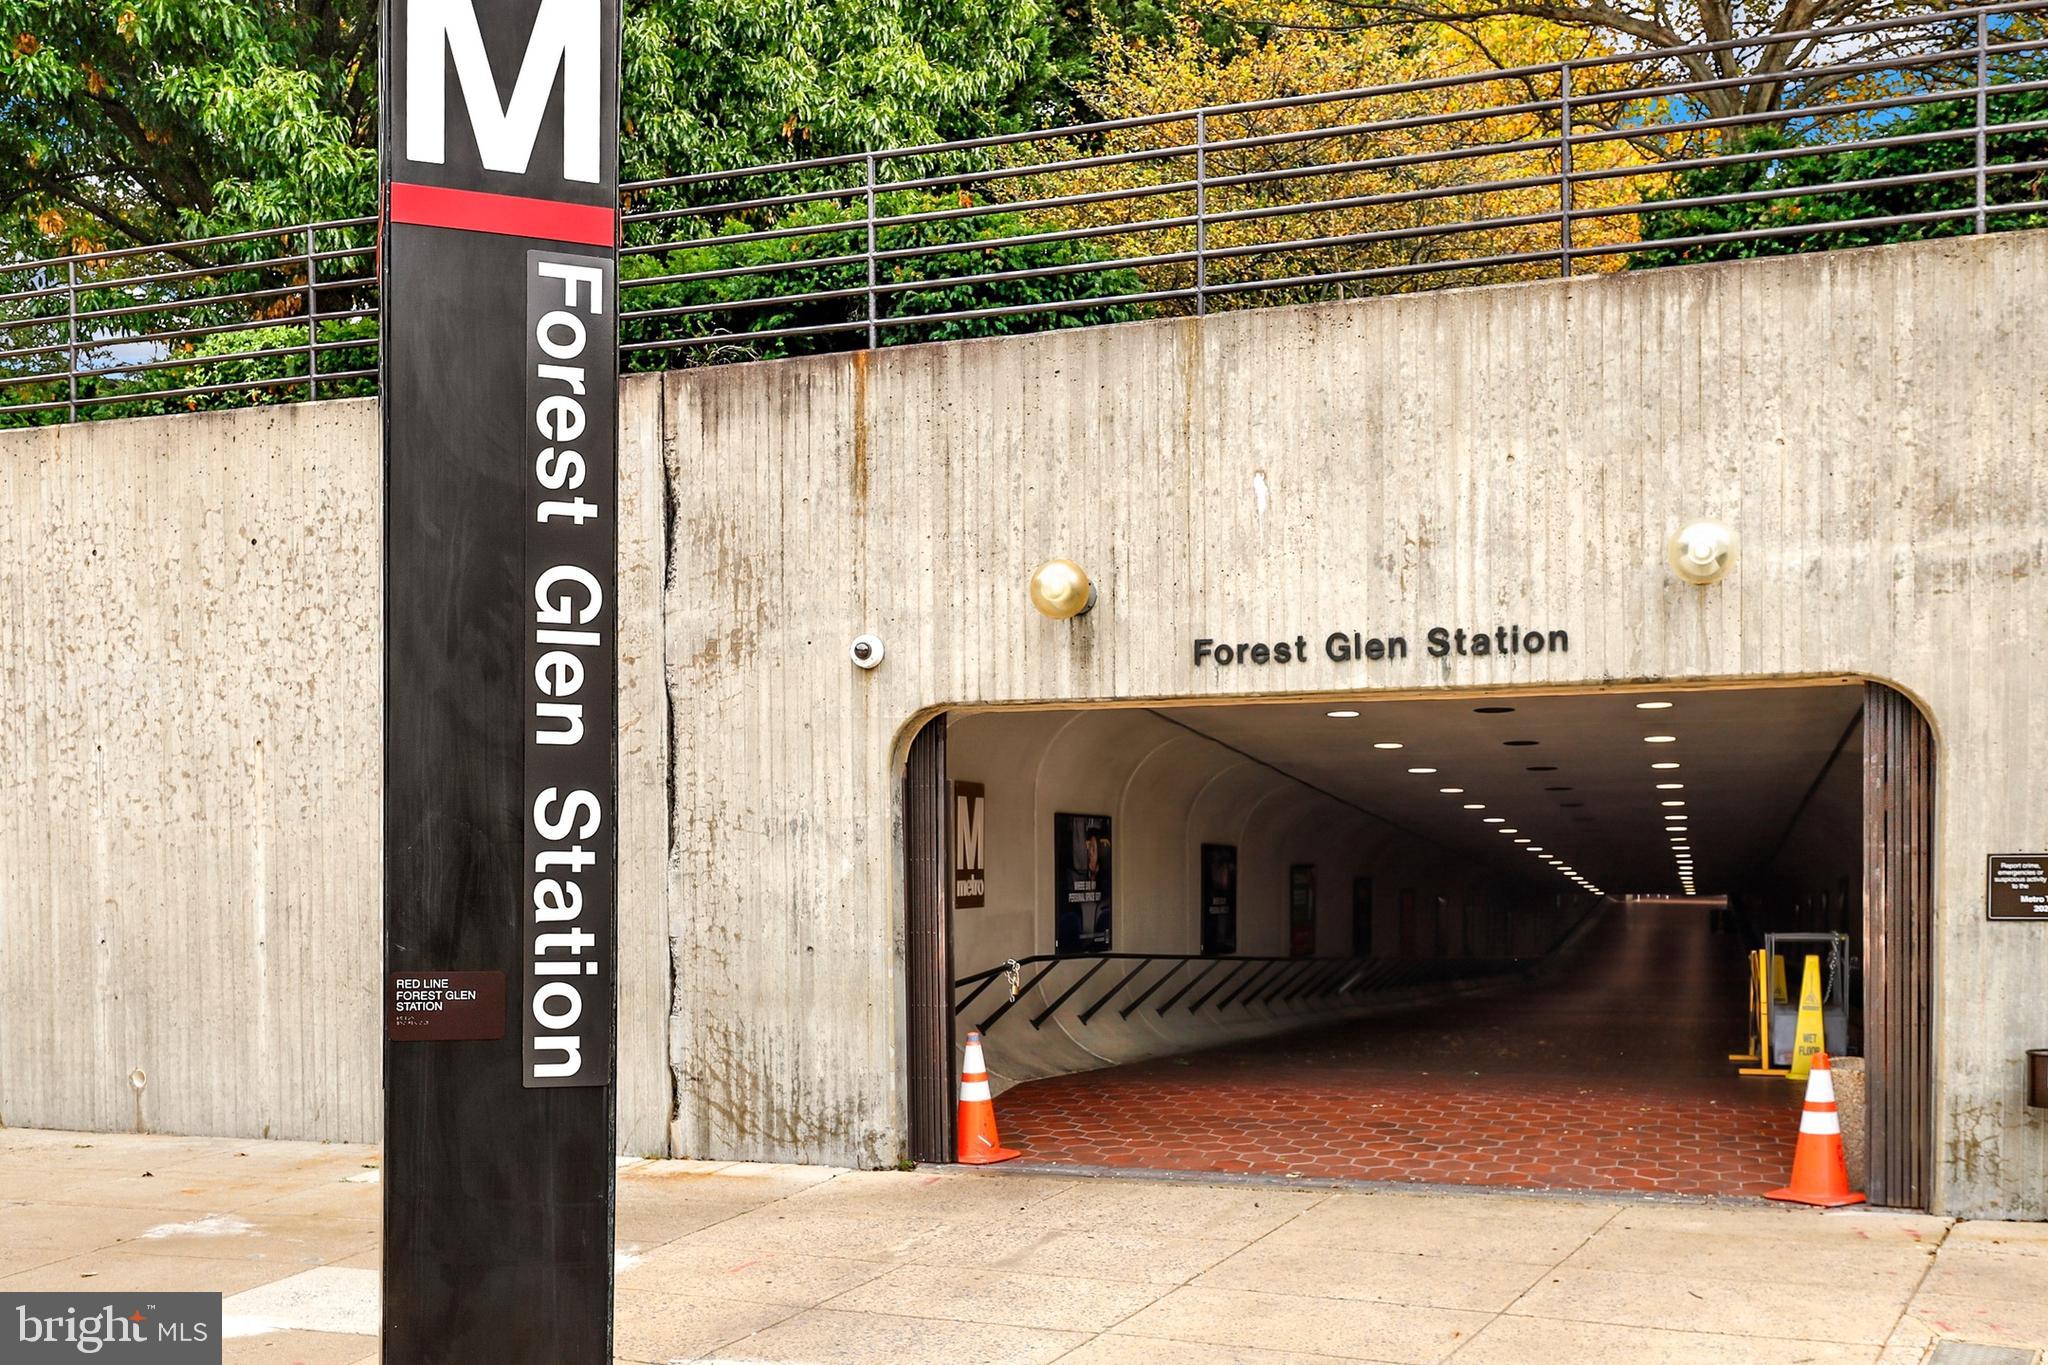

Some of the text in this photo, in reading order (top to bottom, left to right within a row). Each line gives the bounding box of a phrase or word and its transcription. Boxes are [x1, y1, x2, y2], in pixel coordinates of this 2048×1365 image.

[406, 0, 601, 184] M
[1194, 624, 1569, 667] Forest Glen Station
[532, 260, 603, 1078] Forest Glen Station
[956, 795, 985, 870] M
[956, 873, 985, 898] metro
[2020, 895, 2045, 903] Metro
[396, 978, 449, 989] RED LINE
[396, 990, 477, 1001] FOREST GLEN
[396, 1001, 443, 1012] STATION
